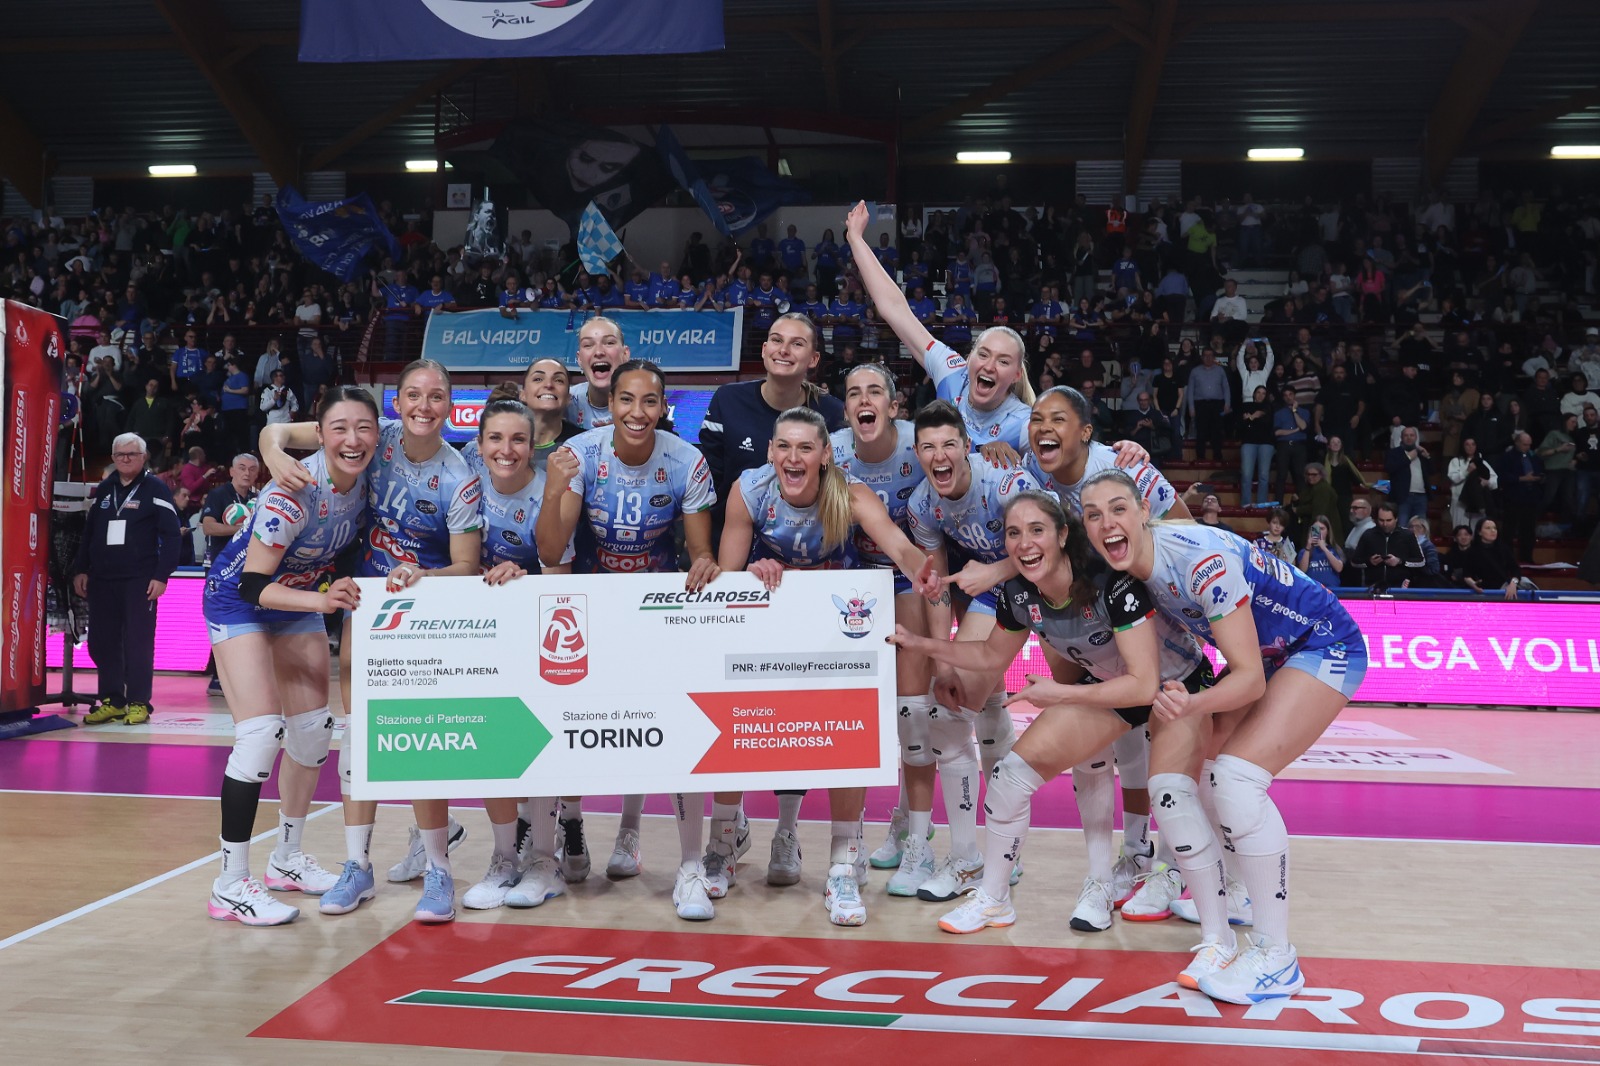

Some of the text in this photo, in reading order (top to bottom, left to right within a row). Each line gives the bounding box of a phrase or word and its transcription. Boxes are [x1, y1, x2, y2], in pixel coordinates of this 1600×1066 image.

[639, 329, 715, 345] NOVARA
[13, 390, 26, 496] FRECCIAROSSA
[40, 399, 54, 501] FRECCIAROSSA
[616, 476, 646, 486] enartis
[267, 496, 301, 520] sterilgarda
[379, 480, 408, 520] 14
[613, 490, 642, 525] 13
[326, 519, 350, 551] 10
[958, 523, 990, 549] 98
[792, 532, 807, 557] 4
[220, 547, 249, 577] GlobalW
[556, 596, 571, 604] LVF
[642, 591, 771, 604] FRECCIAROSSA
[10, 572, 22, 680] FRECCIAROSSA
[409, 618, 497, 630] TRENITALIA
[664, 614, 746, 625] TRENO UFFICIALE
[548, 653, 564, 661] COPPA
[1067, 646, 1093, 668] 6
[1365, 634, 1480, 670] LEGA
[367, 657, 442, 667] Biglietto squadra
[732, 660, 871, 673] PNR: #F4VolleyFrecciarossa
[367, 669, 407, 677] VIAGGIO
[433, 668, 464, 676] INALPI
[466, 667, 499, 675] ARENA
[367, 677, 438, 687] Data: 24/01/2026
[375, 714, 487, 725] Stazione di Partenza:
[562, 710, 657, 721] Stazione di Arrivo:
[732, 706, 777, 717] Servizio:
[733, 720, 865, 734] FINALI COPPA ITALIA
[377, 732, 478, 752] NOVARA
[563, 727, 664, 749] TORINO
[733, 736, 834, 749] FRECCIAROSSA
[1279, 854, 1287, 892] adrenalina
